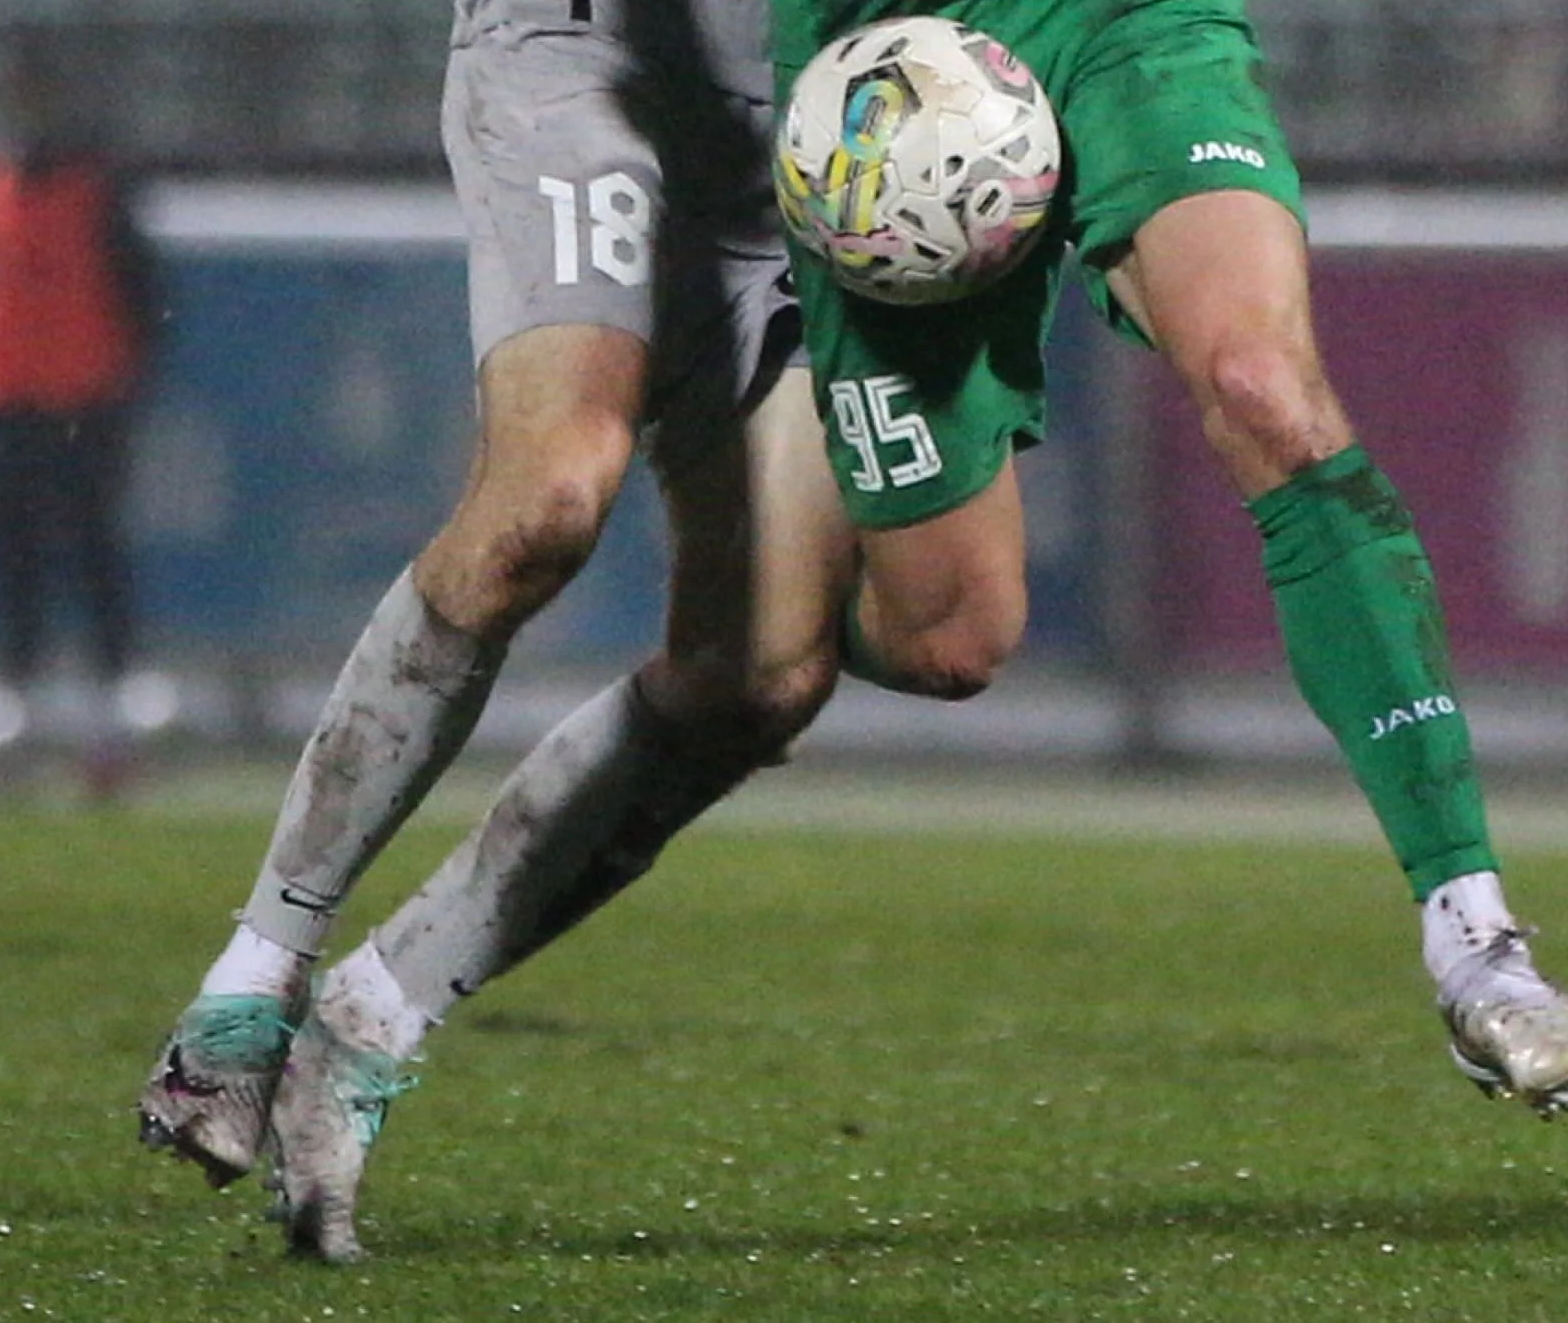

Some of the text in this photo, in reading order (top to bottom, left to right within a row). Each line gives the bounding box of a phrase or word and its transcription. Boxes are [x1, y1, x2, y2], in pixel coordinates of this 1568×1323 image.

[1189, 140, 1265, 170] JAKO
[538, 171, 651, 286] 18
[829, 375, 942, 491] 95
[1370, 695, 1455, 740] JAKO
